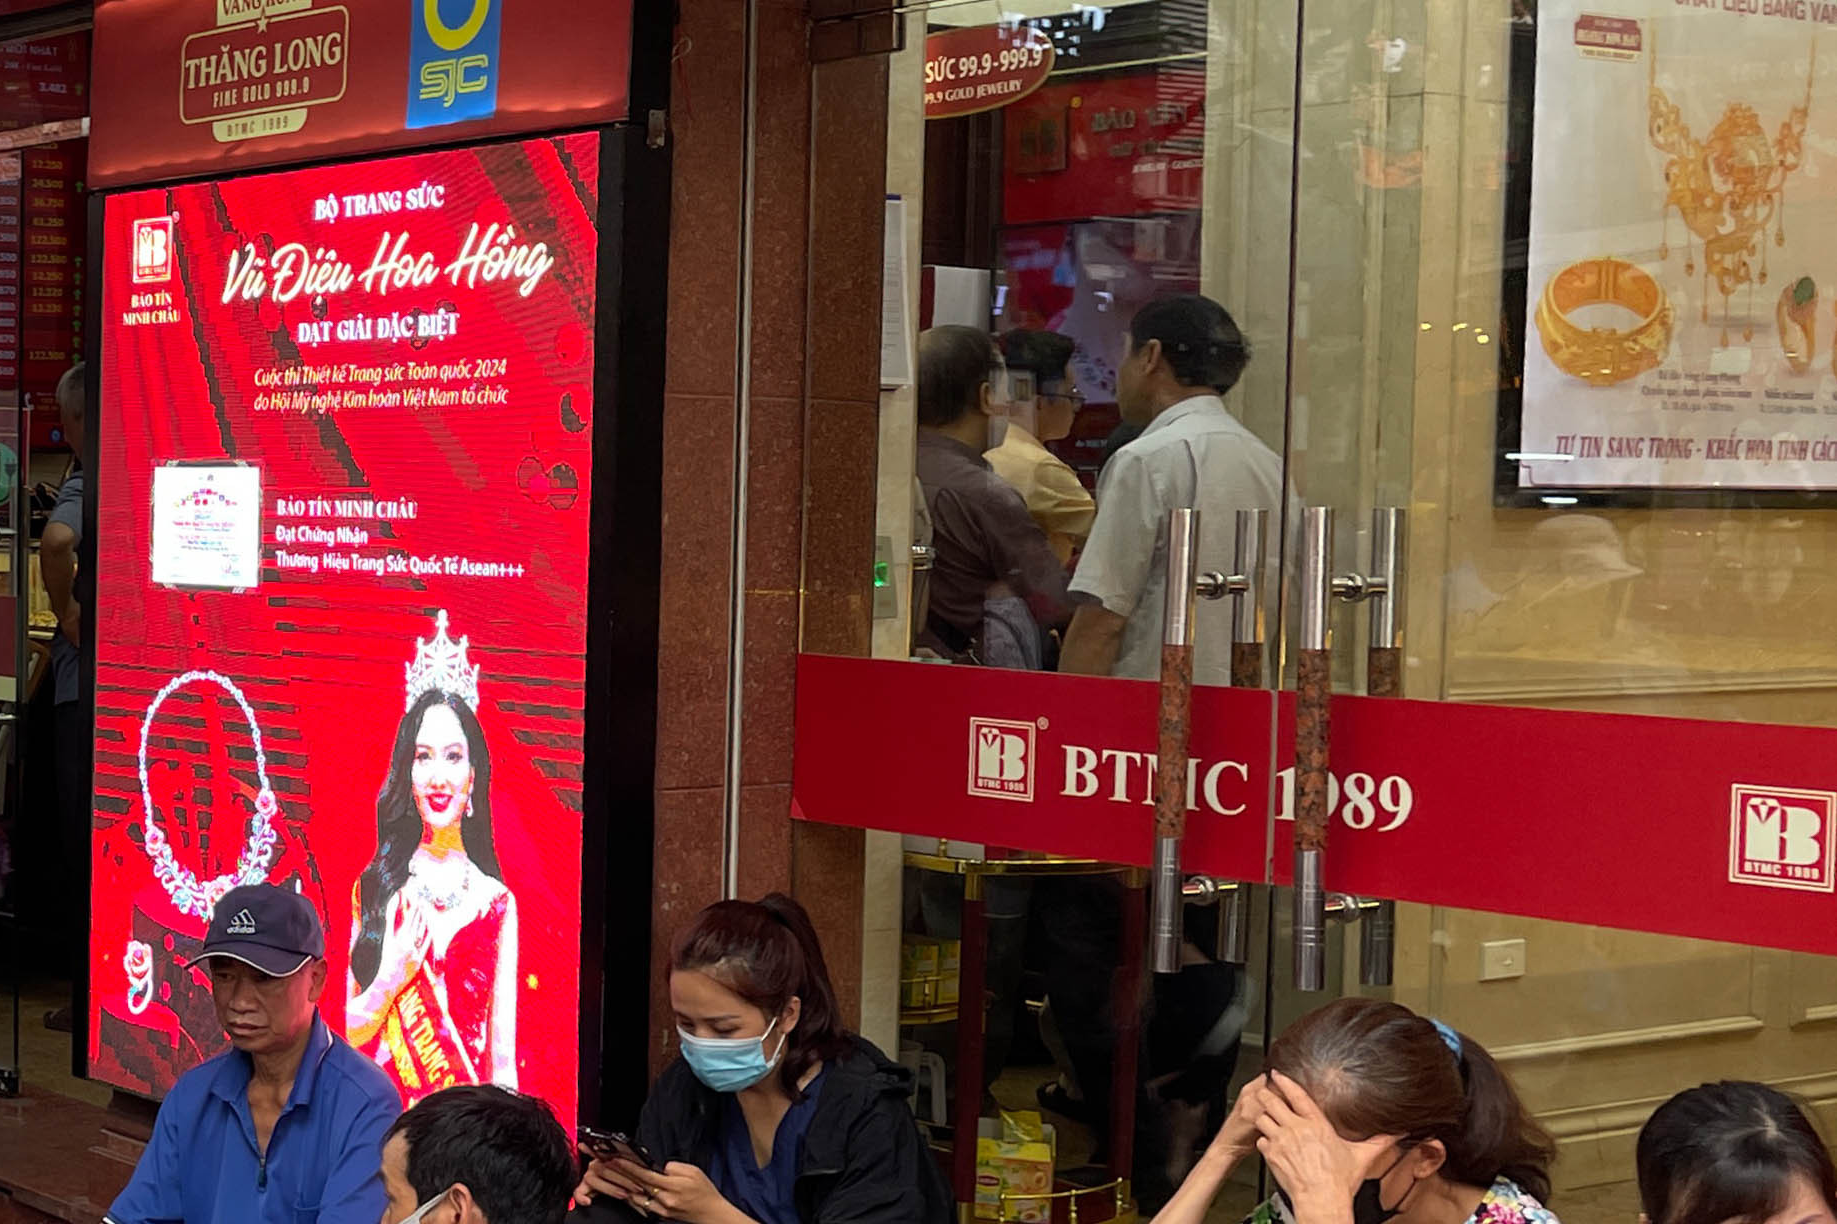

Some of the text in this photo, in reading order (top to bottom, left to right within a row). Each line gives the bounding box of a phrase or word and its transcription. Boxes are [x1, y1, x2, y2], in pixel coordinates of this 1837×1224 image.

[185, 32, 342, 89] THĂNG LONG
[925, 56, 956, 83] SỨC
[213, 89, 238, 108] FINE
[242, 83, 270, 104] GOLD
[945, 86, 974, 103] GOLD
[976, 79, 1023, 99] JEWELRY
[314, 180, 446, 223] BỘ TRANG SỨC
[221, 222, 555, 305] Vũ Điệu Hoa Hồng
[131, 289, 173, 309] BẢO TÍN
[123, 305, 181, 326] MINH CHÂU
[297, 308, 461, 348] ĐẠT GIẢI ĐẶC BIỆT
[254, 358, 507, 390] Cuộc thi Thiết kế Trang sức Toàn quốc 2024
[254, 391, 269, 411] do
[270, 391, 291, 414] Hội
[312, 389, 341, 415] nghệ
[342, 390, 367, 409] Kim
[368, 388, 401, 408] hoàn
[403, 387, 426, 411] Việt
[427, 387, 459, 407] Nam
[461, 383, 476, 405] tổ
[477, 384, 509, 405] chức
[1579, 435, 1604, 458] TIN
[1606, 436, 1644, 459] SANG
[1648, 438, 1694, 464] TRỌNG
[1706, 428, 1743, 460] KHẮC
[277, 495, 418, 519] BẢO TÍN MINH CHÂU
[275, 525, 368, 548] Đạt Chứng Nhận
[275, 550, 319, 573] Thương
[323, 552, 350, 574] Hiệu
[350, 553, 385, 576] Trang
[386, 553, 408, 573] Sức
[409, 554, 442, 575] Quốc
[443, 554, 459, 575] Tế
[977, 778, 1001, 790] BTMC
[1744, 860, 1820, 880] BTMC 1989
